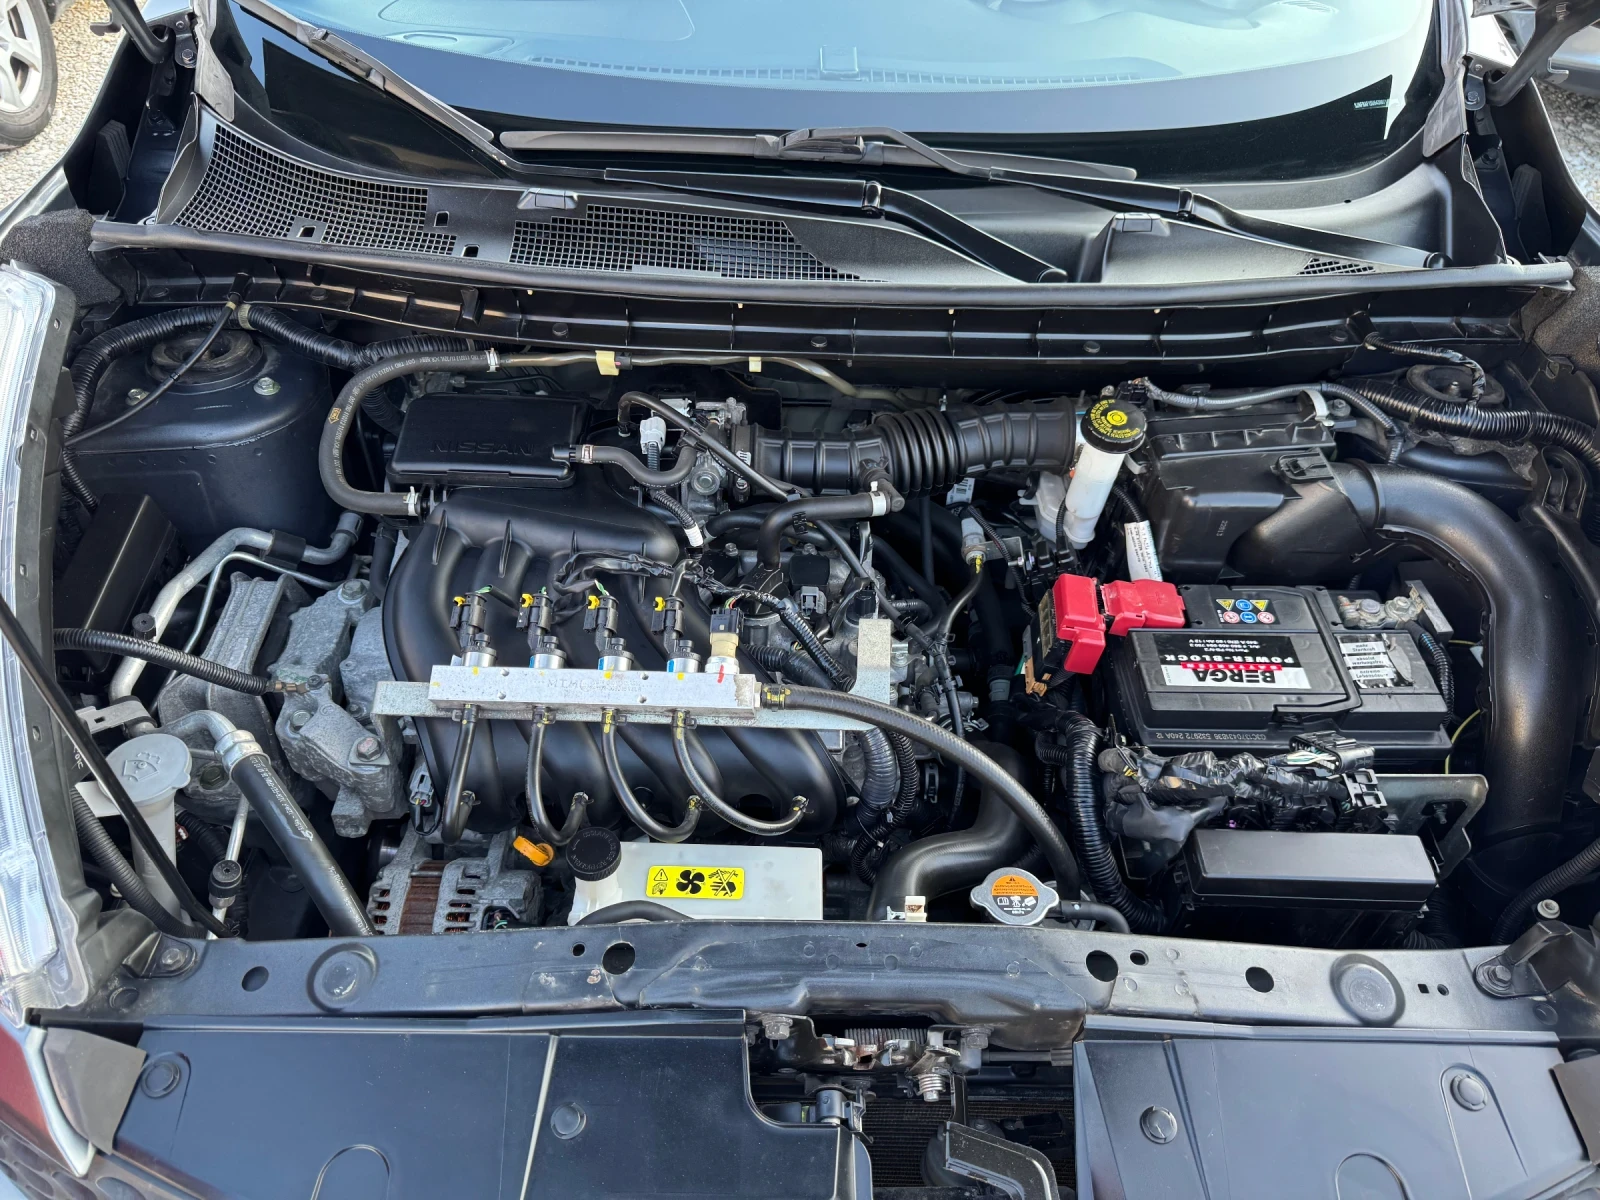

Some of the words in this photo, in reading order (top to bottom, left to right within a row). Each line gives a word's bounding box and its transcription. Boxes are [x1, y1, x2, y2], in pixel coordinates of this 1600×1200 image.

[429, 441, 535, 456] NISSAN
[1164, 654, 1294, 664] POWER-BLOCK
[1186, 662, 1278, 671] BATTERIEN
[1192, 669, 1276, 684] BERGA
